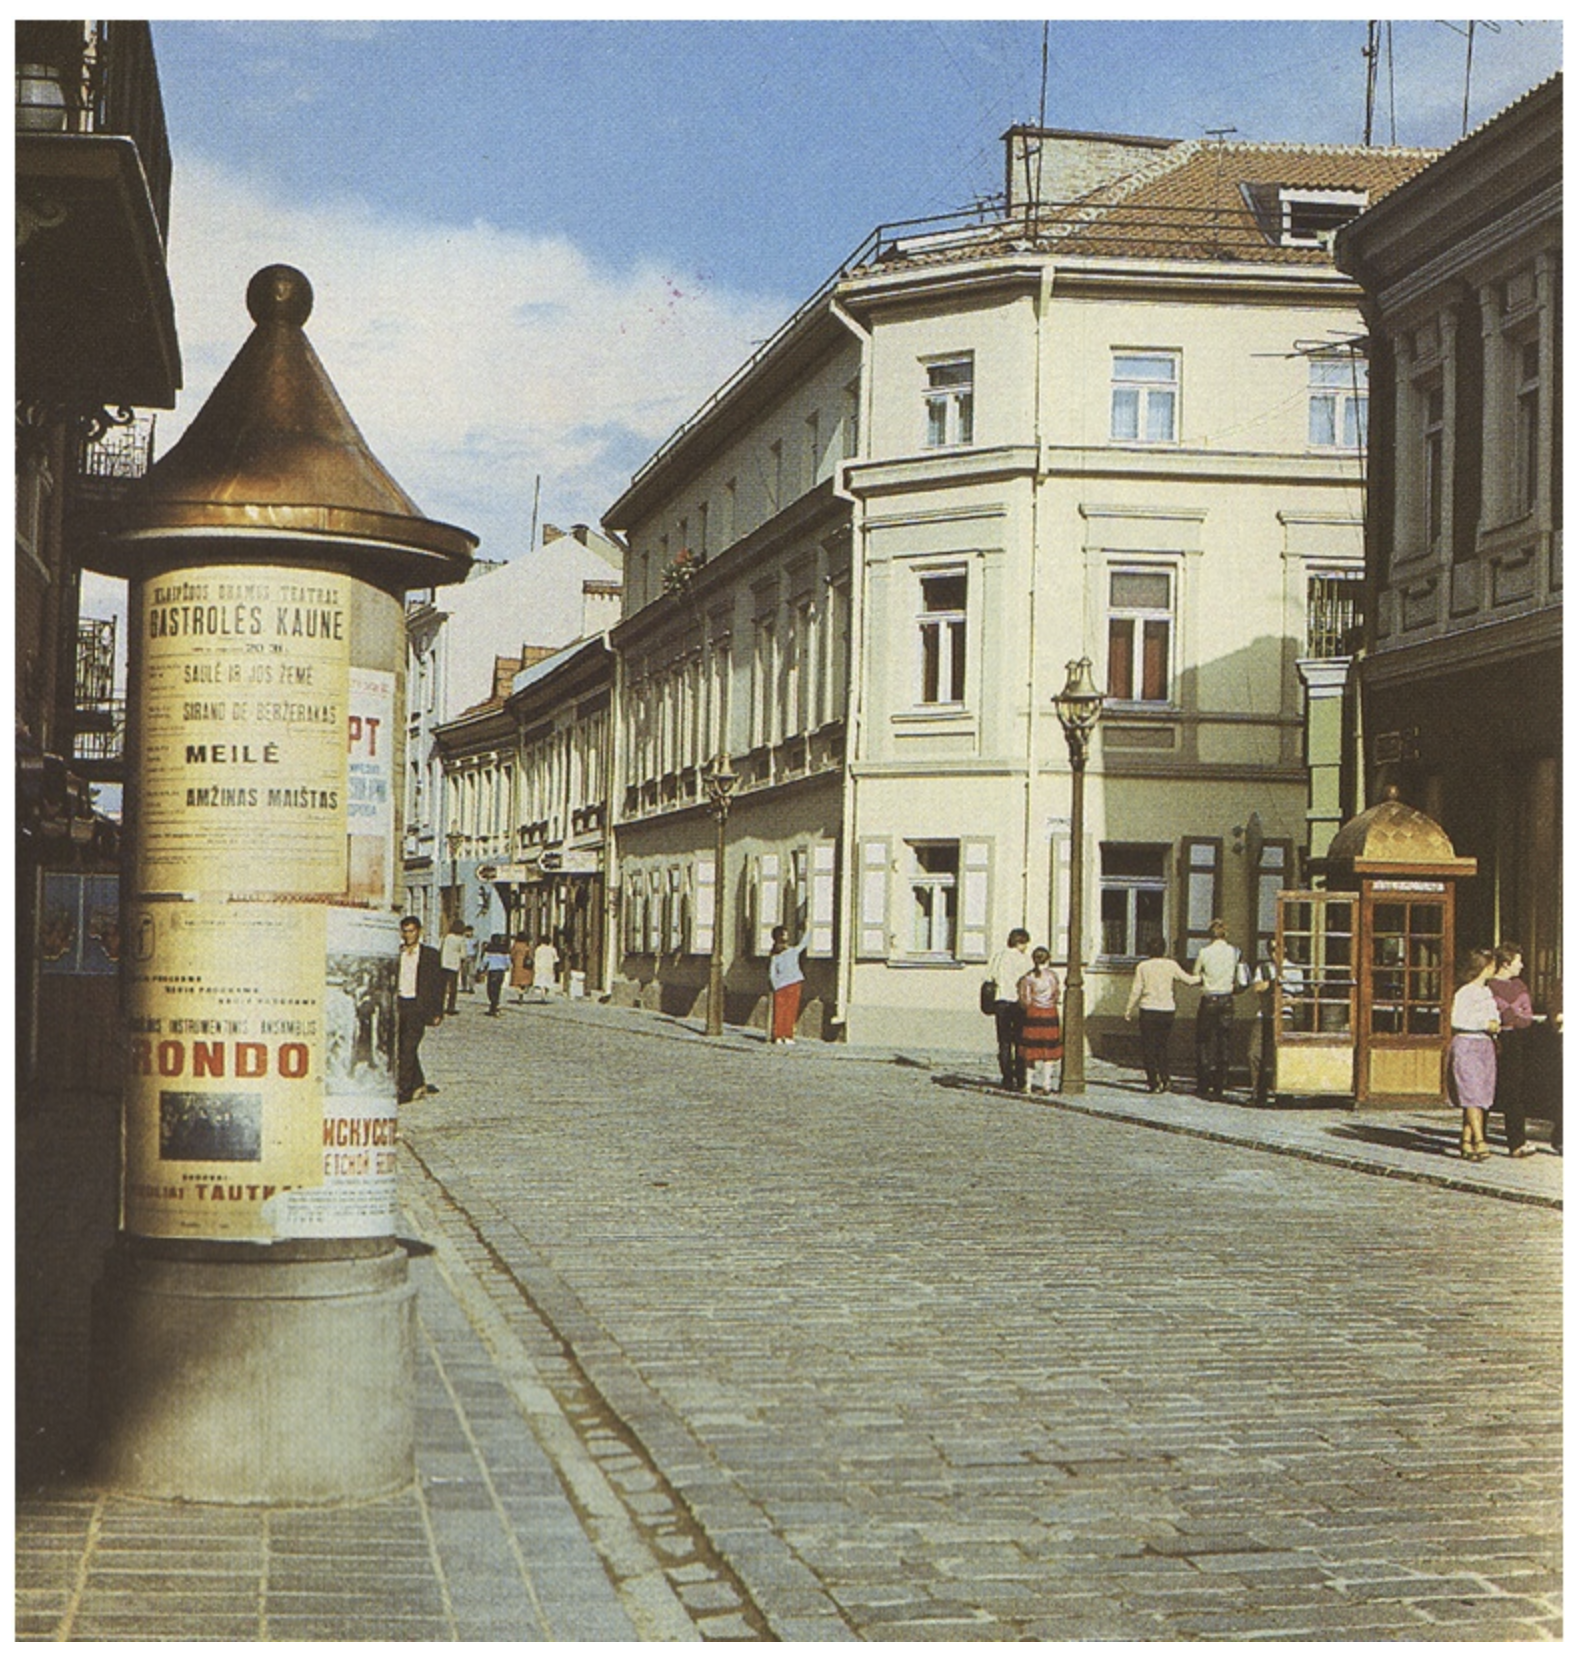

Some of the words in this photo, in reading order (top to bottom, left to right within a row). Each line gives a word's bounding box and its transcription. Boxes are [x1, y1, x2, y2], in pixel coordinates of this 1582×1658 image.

[149, 602, 262, 639] GASTROLĖS
[276, 606, 343, 640] KAUNE
[186, 742, 279, 764] MEILĖ
[186, 786, 258, 807] AMŽINAS
[267, 786, 338, 810] MAIŠTAS
